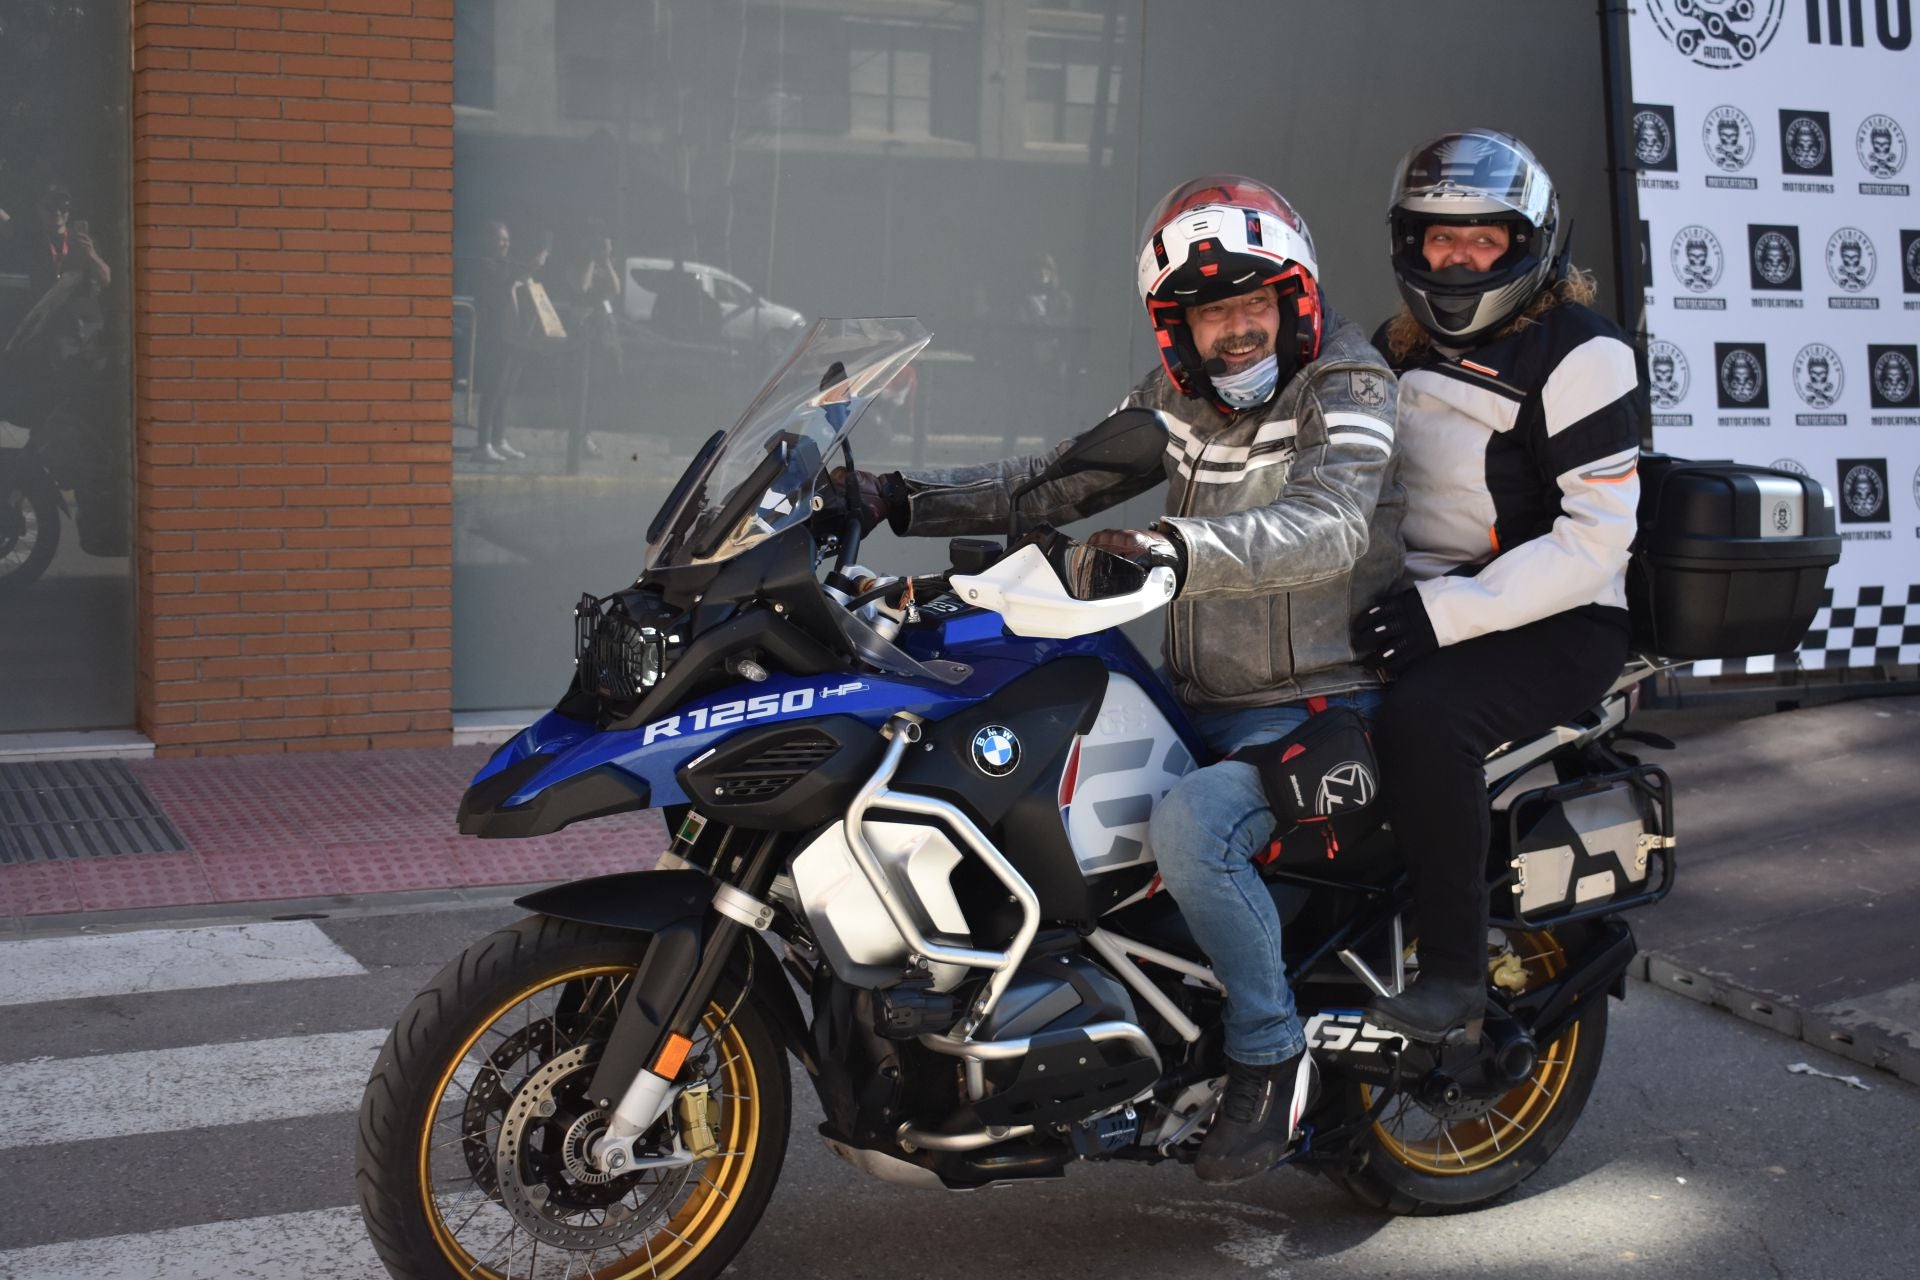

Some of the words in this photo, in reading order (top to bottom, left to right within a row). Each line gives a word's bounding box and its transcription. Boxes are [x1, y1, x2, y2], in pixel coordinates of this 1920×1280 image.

[1703, 46, 1732, 60] AUTOL
[1637, 178, 1679, 190] TOCATONGS
[1782, 182, 1834, 193] MOTOCATONGS
[1752, 298, 1803, 308] MOTOCATONGS
[1718, 417, 1770, 426] MOTOCATONGS
[642, 715, 682, 746] R
[688, 688, 815, 731] 1250
[976, 728, 1012, 746] BMW
